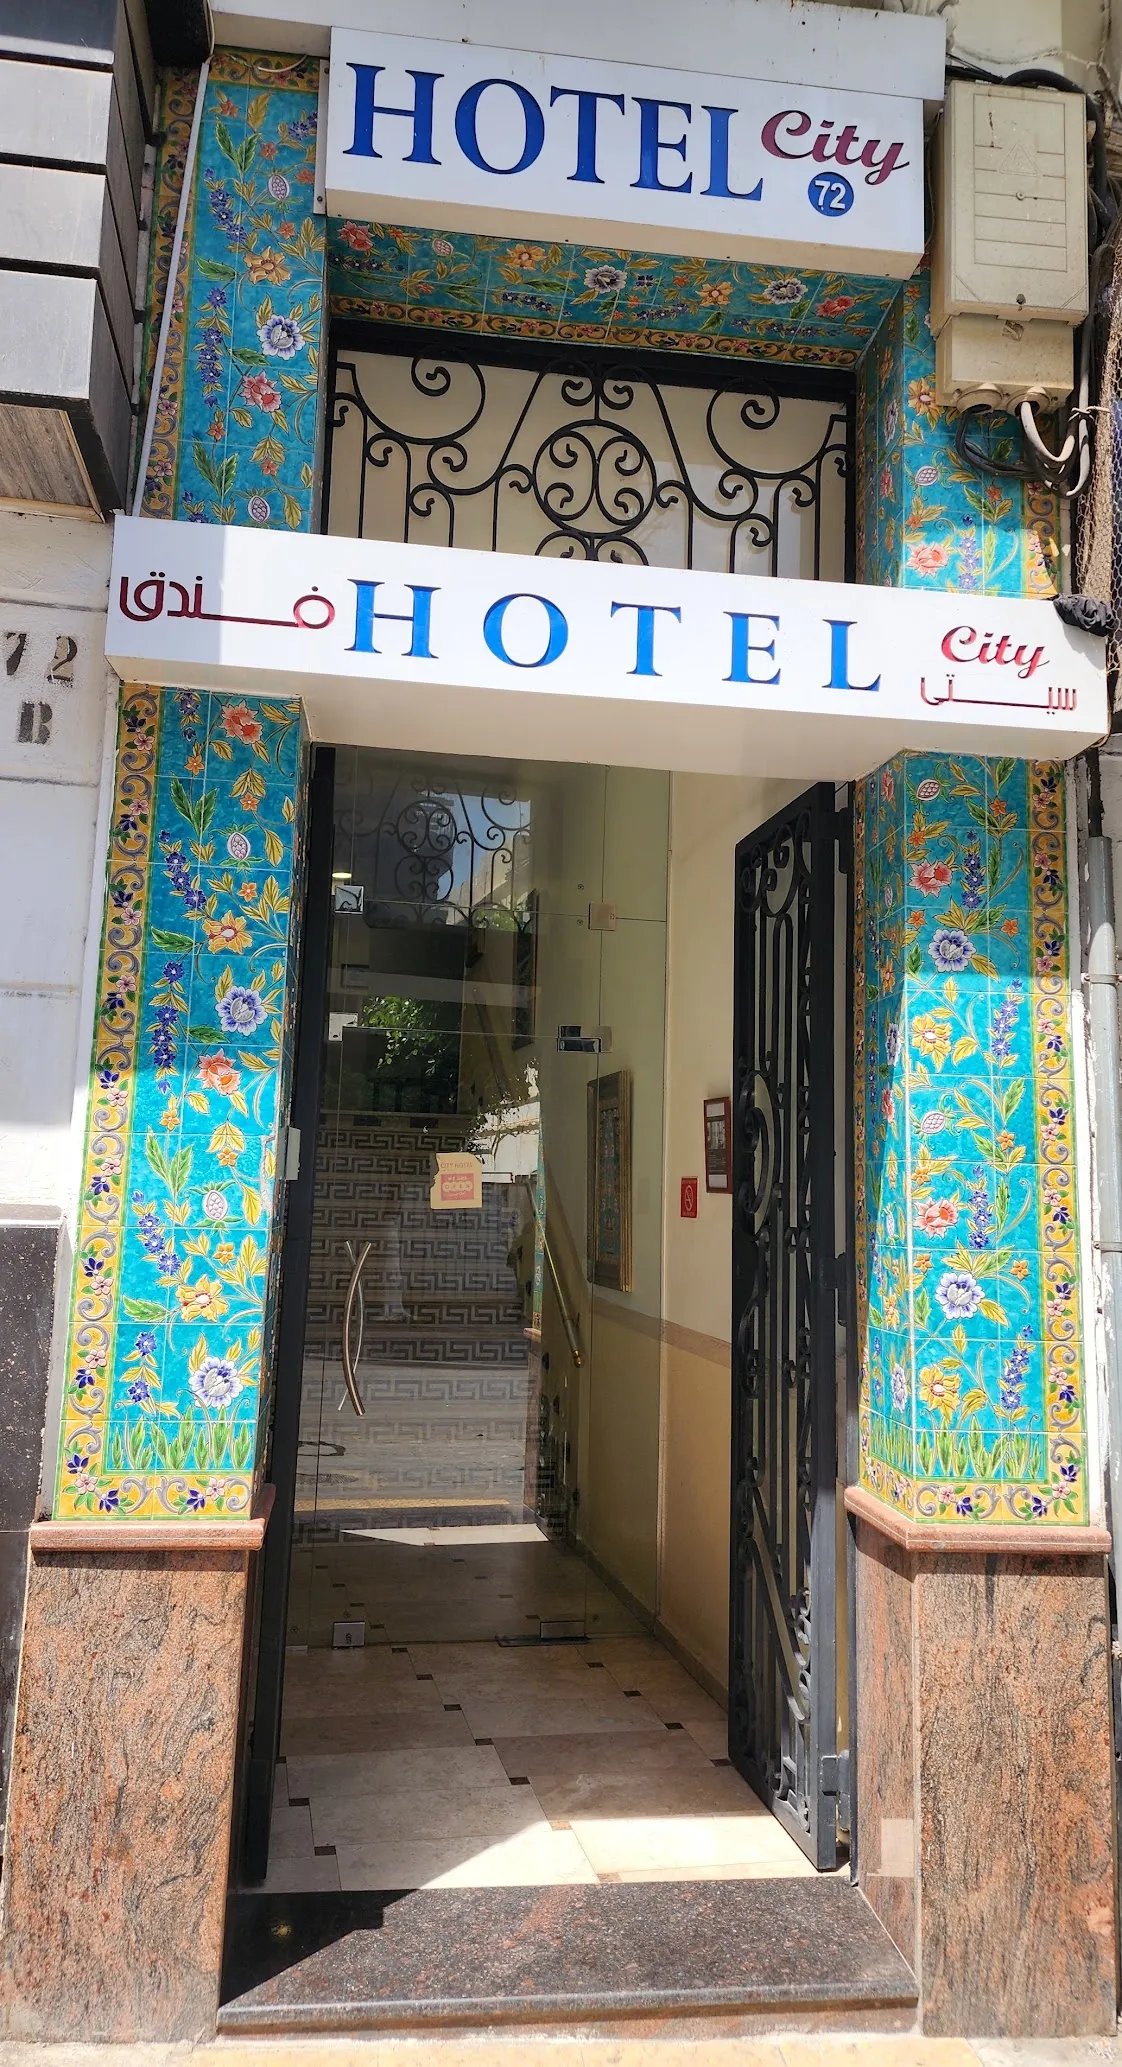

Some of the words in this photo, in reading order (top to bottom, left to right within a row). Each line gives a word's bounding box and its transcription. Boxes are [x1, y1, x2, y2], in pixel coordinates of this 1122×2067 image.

[343, 61, 763, 202] HOTEL
[760, 108, 910, 186] City
[814, 179, 846, 209] 72
[120, 570, 336, 630] فندق
[3, 631, 78, 688] 72
[343, 576, 881, 694] HOTEL
[939, 623, 1050, 680] City
[18, 701, 53, 744] B
